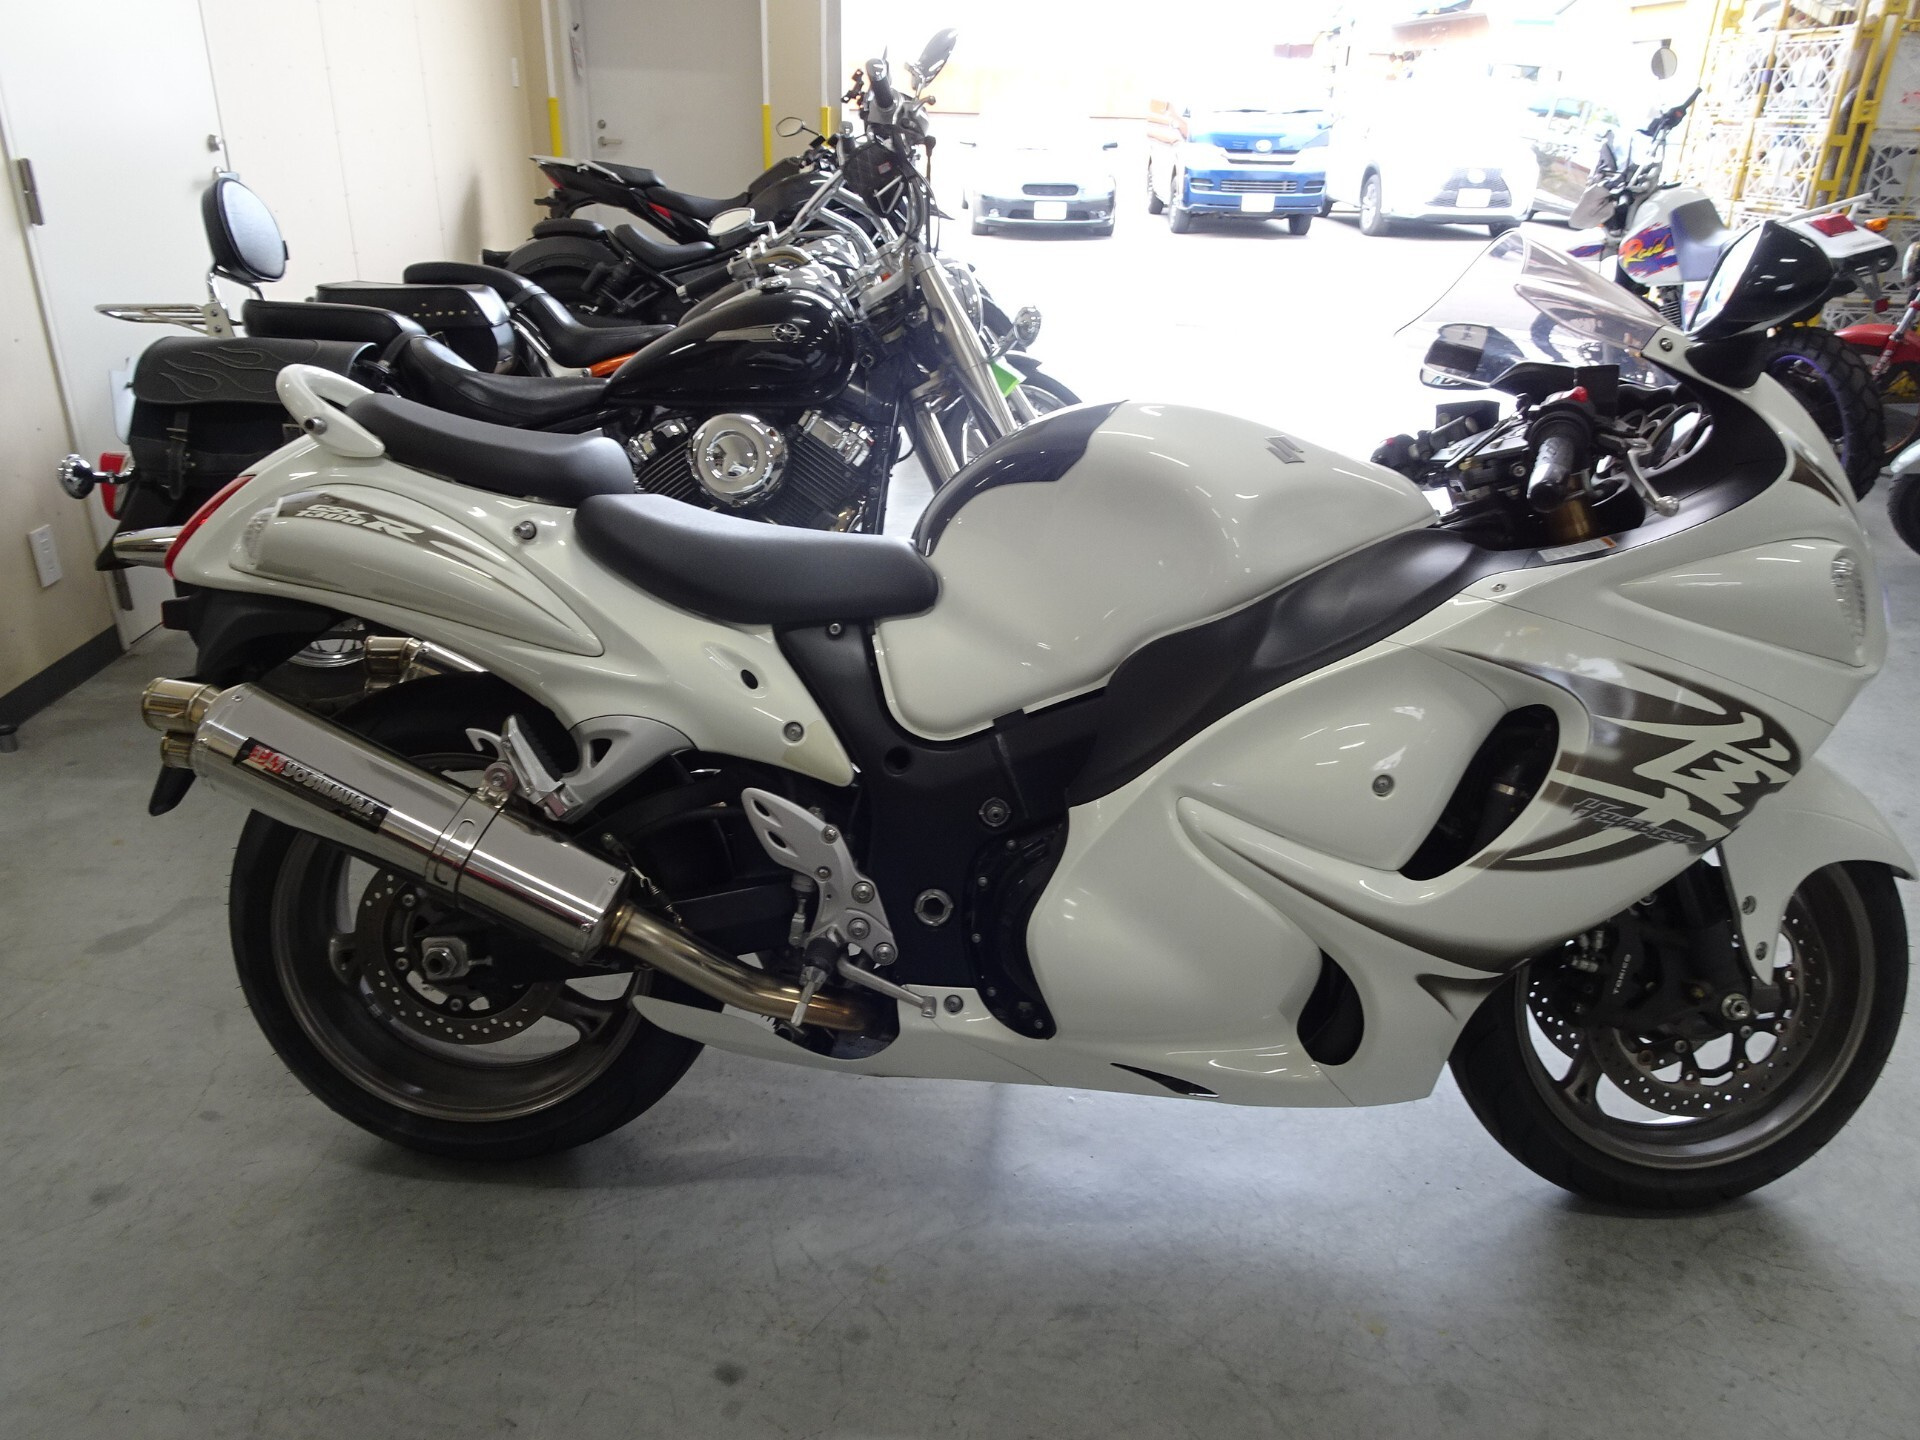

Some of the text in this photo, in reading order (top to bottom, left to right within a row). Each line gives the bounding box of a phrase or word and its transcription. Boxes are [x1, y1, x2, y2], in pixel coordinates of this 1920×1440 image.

[295, 510, 368, 526] 1300
[281, 761, 376, 815] YOSHIMURA
[1572, 797, 1697, 844] Hayabusa
